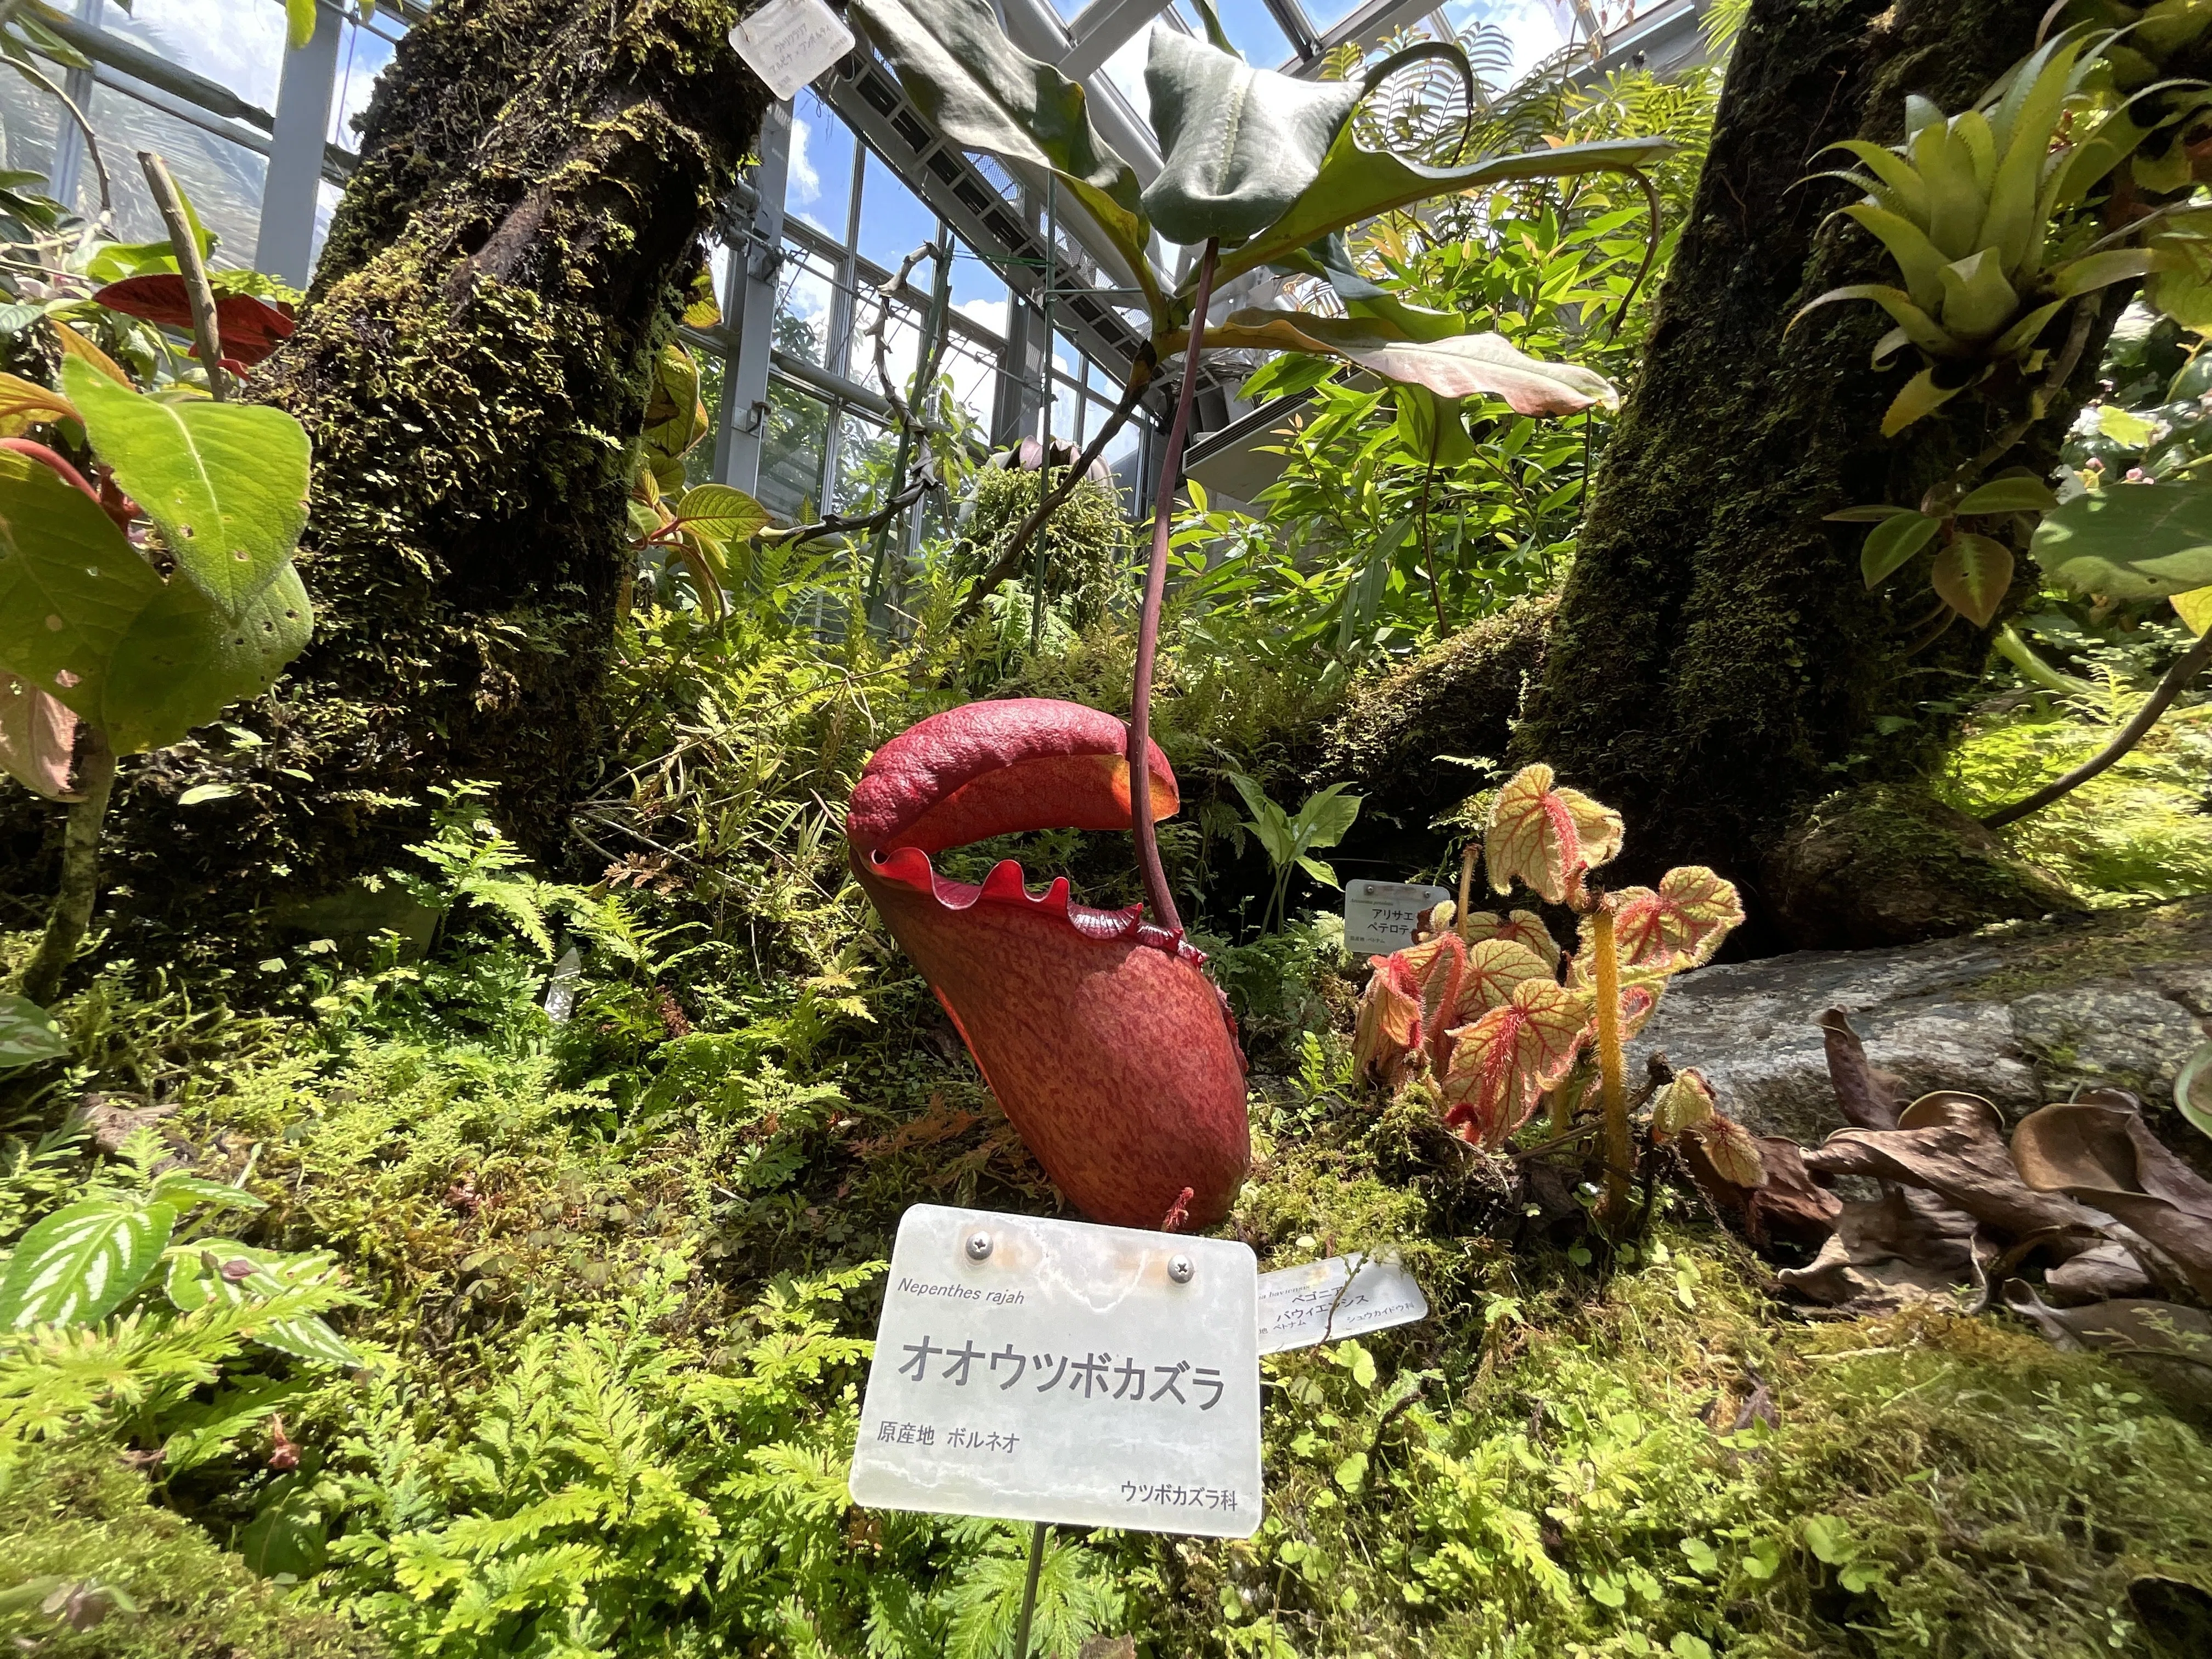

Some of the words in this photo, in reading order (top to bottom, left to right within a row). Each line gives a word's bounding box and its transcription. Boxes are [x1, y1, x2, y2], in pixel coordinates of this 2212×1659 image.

[1372, 909, 1414, 921] アリサエ
[1367, 922, 1412, 935] ペテロテ
[898, 1278, 981, 1300] Nepenthes
[986, 1289, 1025, 1305] rajah
[1291, 1286, 1344, 1303] ベゴニア
[1346, 1301, 1415, 1323] シュウカイドウ科
[898, 1335, 1224, 1411] オオウツボカズラ
[877, 1420, 935, 1446] 原産地
[947, 1427, 1020, 1454] ボルネオ
[1121, 1481, 1238, 1511] ウツボカズラ科
